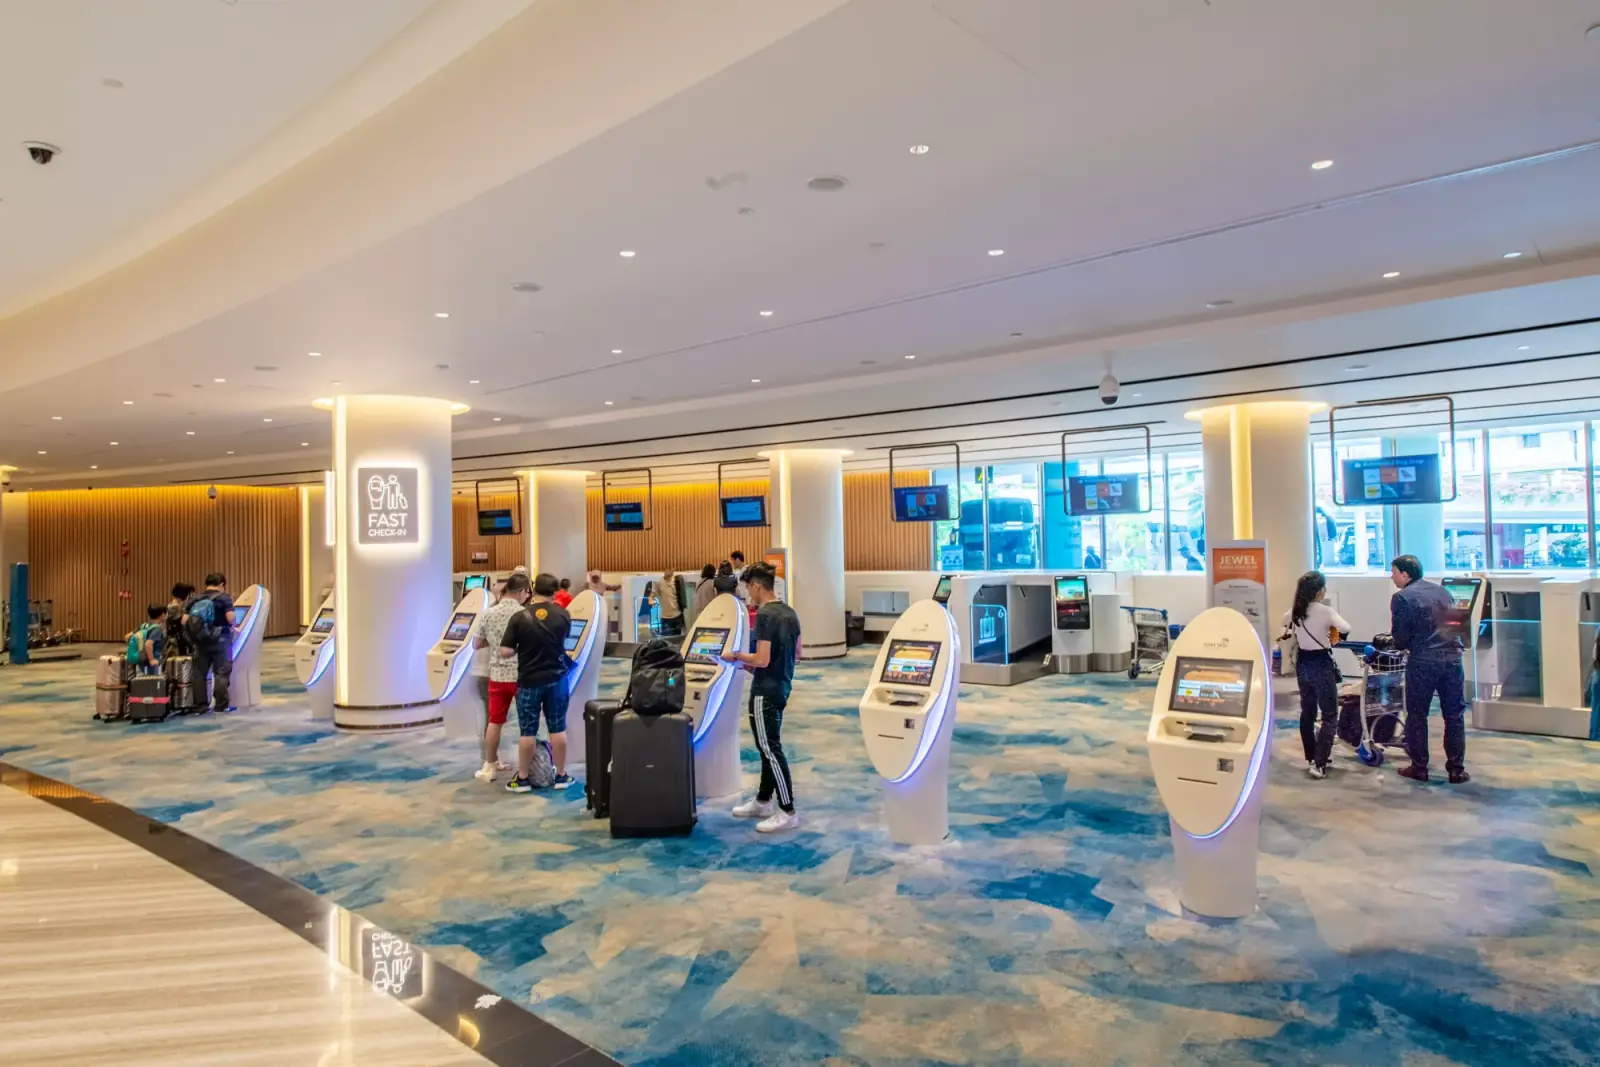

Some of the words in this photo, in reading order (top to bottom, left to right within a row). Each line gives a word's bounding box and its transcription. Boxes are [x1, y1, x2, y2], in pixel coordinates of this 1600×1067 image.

[368, 513, 408, 527] FAST
[368, 528, 407, 537] CHECK-IN
[1219, 555, 1257, 565] JEWEL
[997, 609, 1004, 618] 6
[1478, 623, 1487, 636] 7
